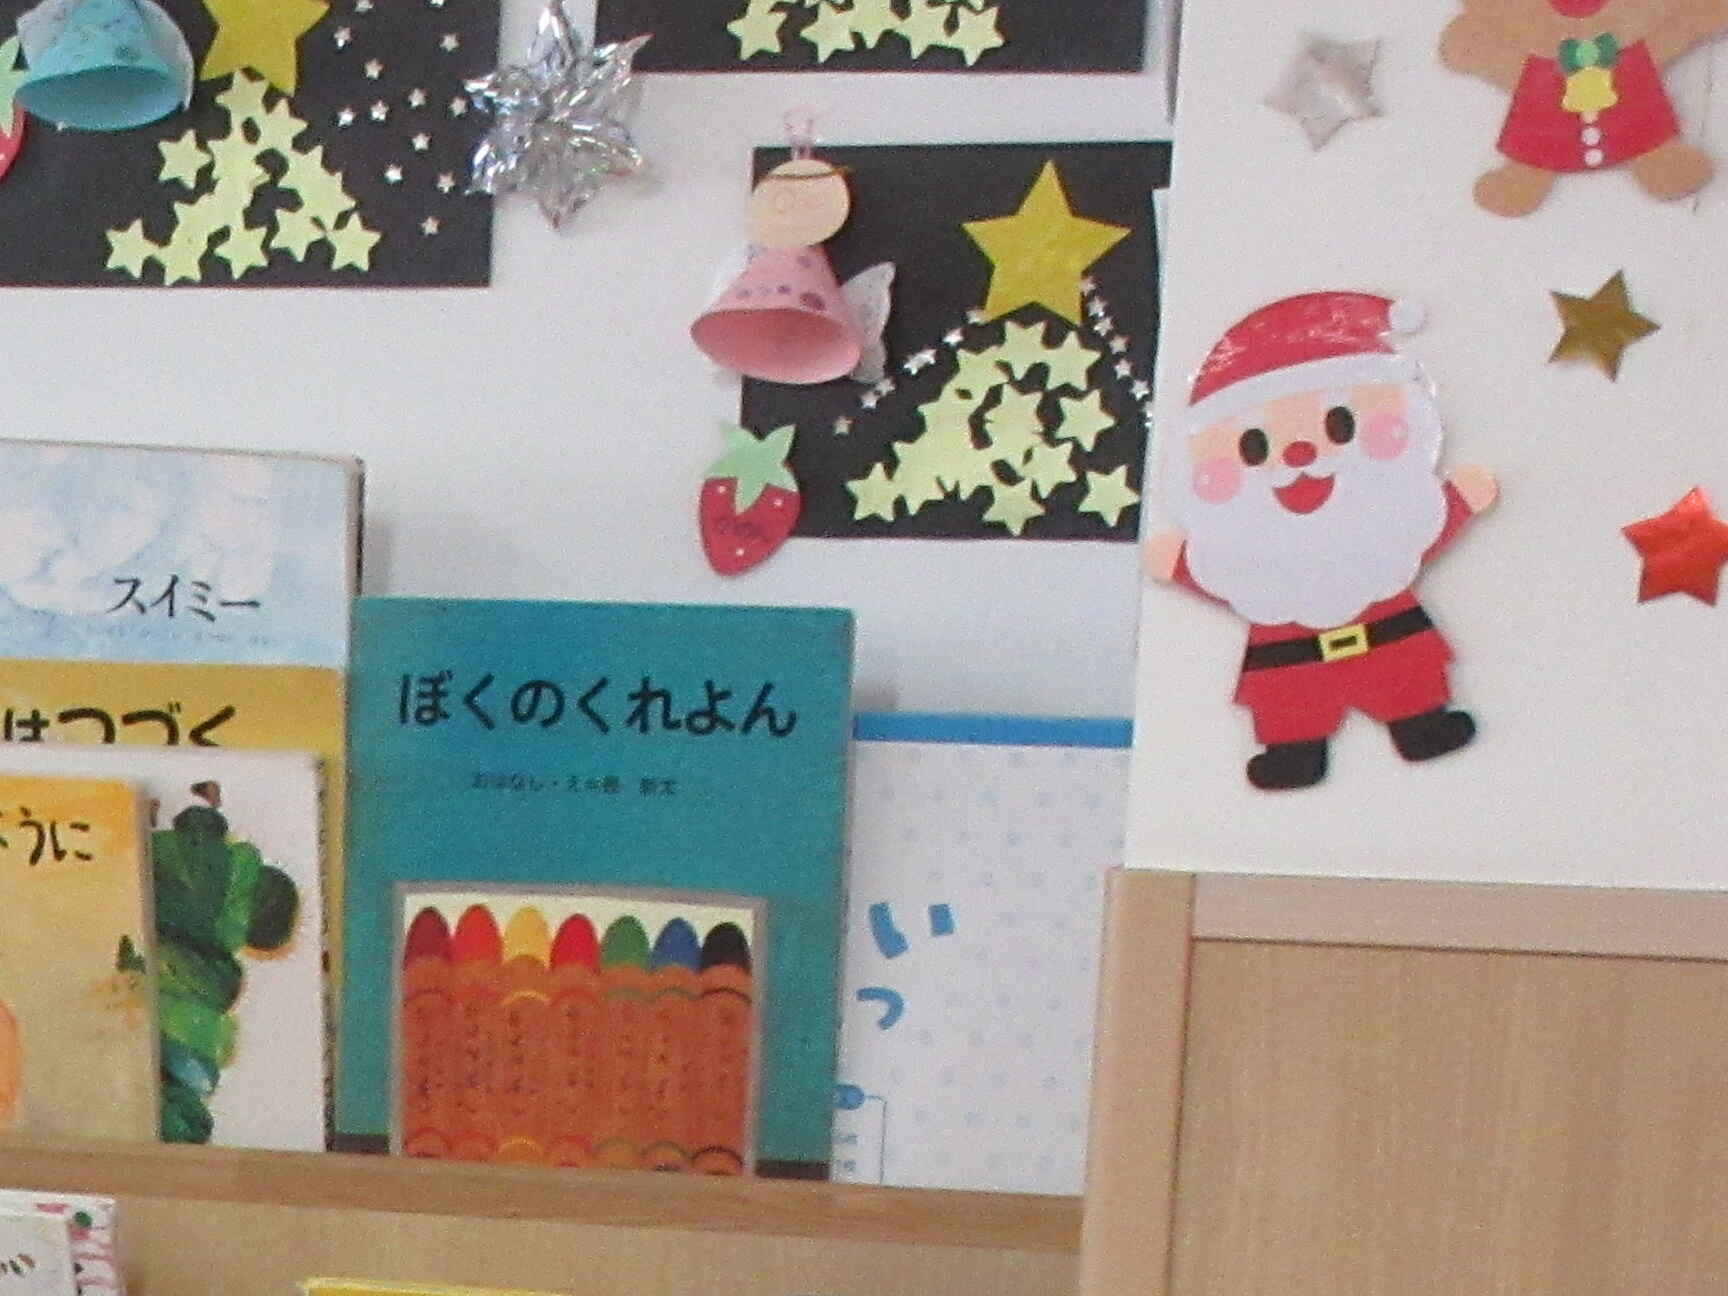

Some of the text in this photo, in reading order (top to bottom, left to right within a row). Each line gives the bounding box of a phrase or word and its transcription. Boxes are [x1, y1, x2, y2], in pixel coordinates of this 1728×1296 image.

[104, 574, 261, 622] スイミー
[396, 669, 799, 737] ぼくのくれよん
